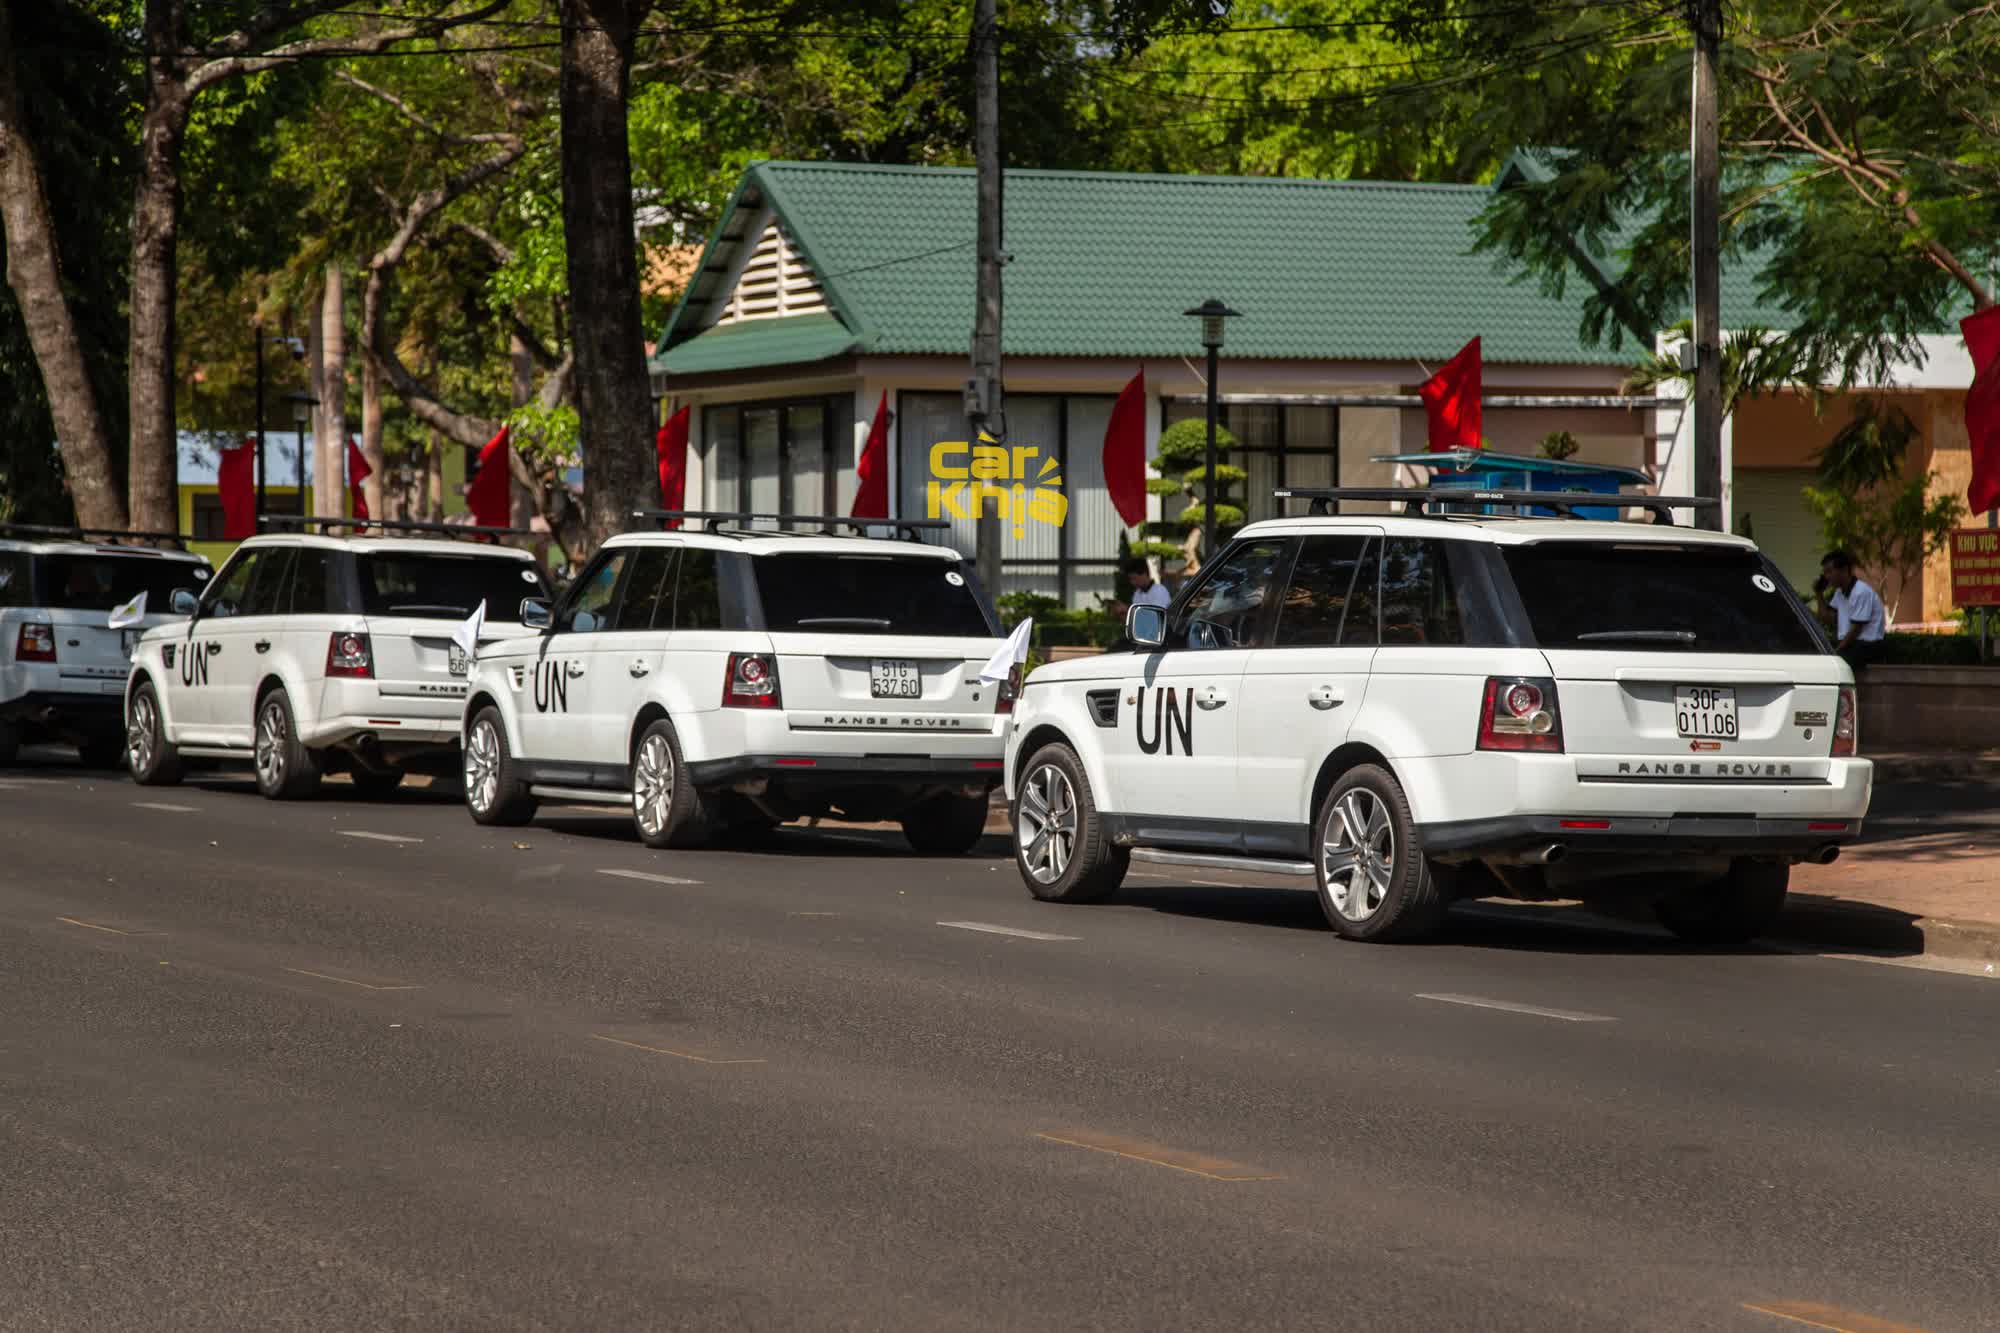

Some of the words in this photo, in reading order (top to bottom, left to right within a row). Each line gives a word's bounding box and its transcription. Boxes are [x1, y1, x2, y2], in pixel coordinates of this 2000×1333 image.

[1957, 535, 1976, 553] KHU
[182, 640, 208, 687] UN
[881, 661, 908, 678] 51G
[535, 660, 568, 713] UN
[872, 678, 918, 695] 537.60
[1689, 688, 1721, 711] 30F
[824, 716, 888, 725] RANGE
[900, 718, 960, 726] ROVER
[1136, 686, 1194, 756] UN
[1678, 711, 1735, 735] 011.06
[1617, 762, 1701, 775] RANGE
[1717, 763, 1792, 776] ROVER
